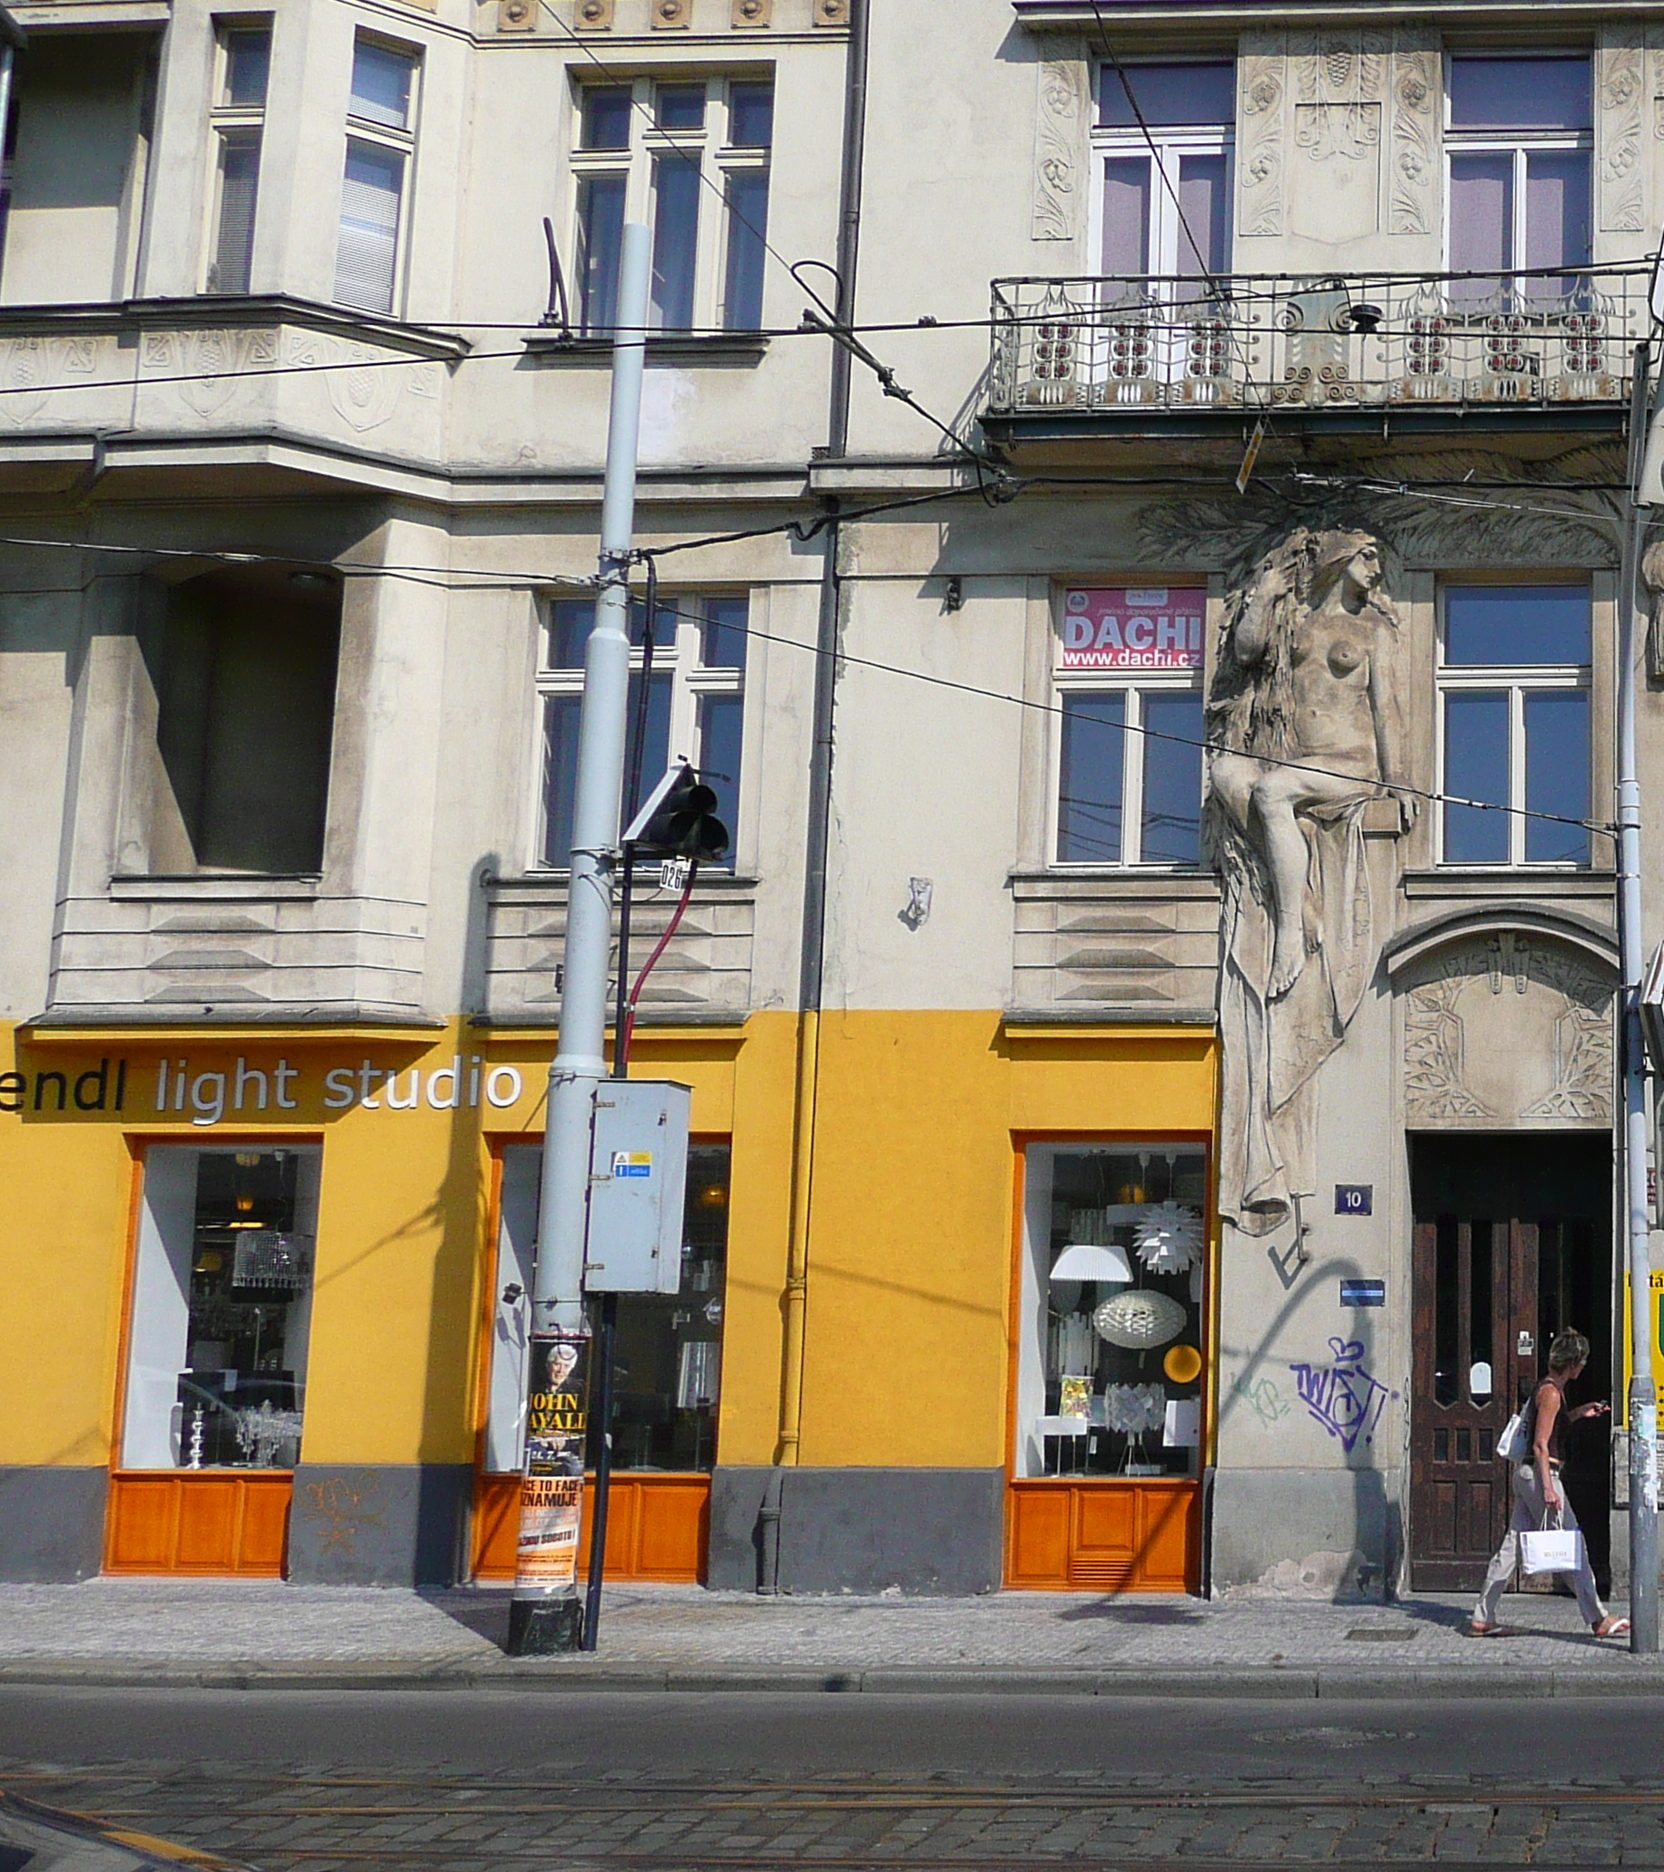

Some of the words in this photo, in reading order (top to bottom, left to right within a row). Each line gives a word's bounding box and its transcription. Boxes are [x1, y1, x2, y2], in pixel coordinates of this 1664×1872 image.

[1065, 616, 1201, 650] DACHI
[1064, 649, 1200, 667] www.dachi.cz
[662, 865, 681, 889] 026
[0, 1059, 126, 1112] endl
[157, 1057, 299, 1126] light
[324, 1055, 522, 1109] studio
[1345, 1191, 1362, 1208] 10
[540, 1480, 552, 1491] TO
[555, 1480, 579, 1491] FACE
